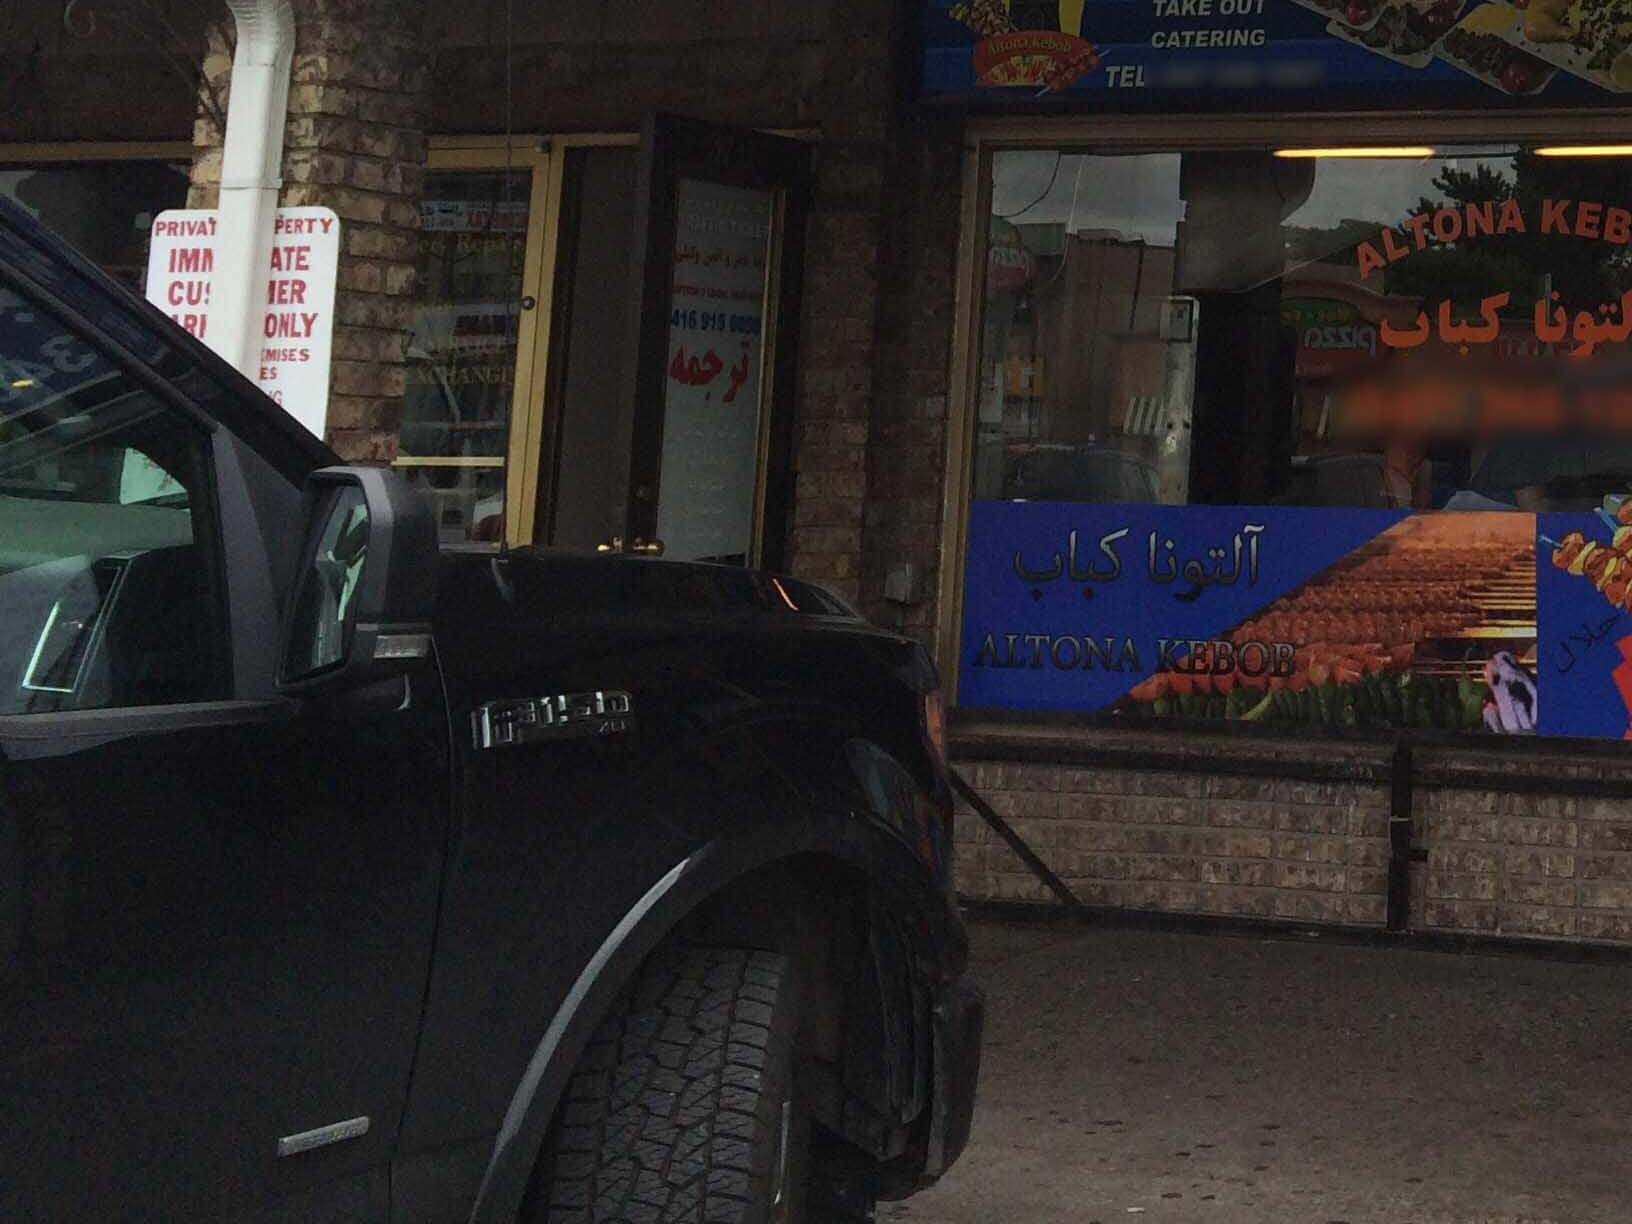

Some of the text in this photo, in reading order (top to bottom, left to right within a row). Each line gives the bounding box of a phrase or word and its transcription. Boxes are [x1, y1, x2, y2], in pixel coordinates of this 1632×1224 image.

[1151, 28, 1266, 49] CATERING
[155, 217, 217, 237] PRIVAT
[1356, 200, 1526, 280] ALTONA
[264, 312, 319, 339] ONLY
[1380, 292, 1511, 355] کباب
[1013, 523, 1265, 602] آلتونا کباب
[974, 633, 1297, 677] ALTONA KEBOB
